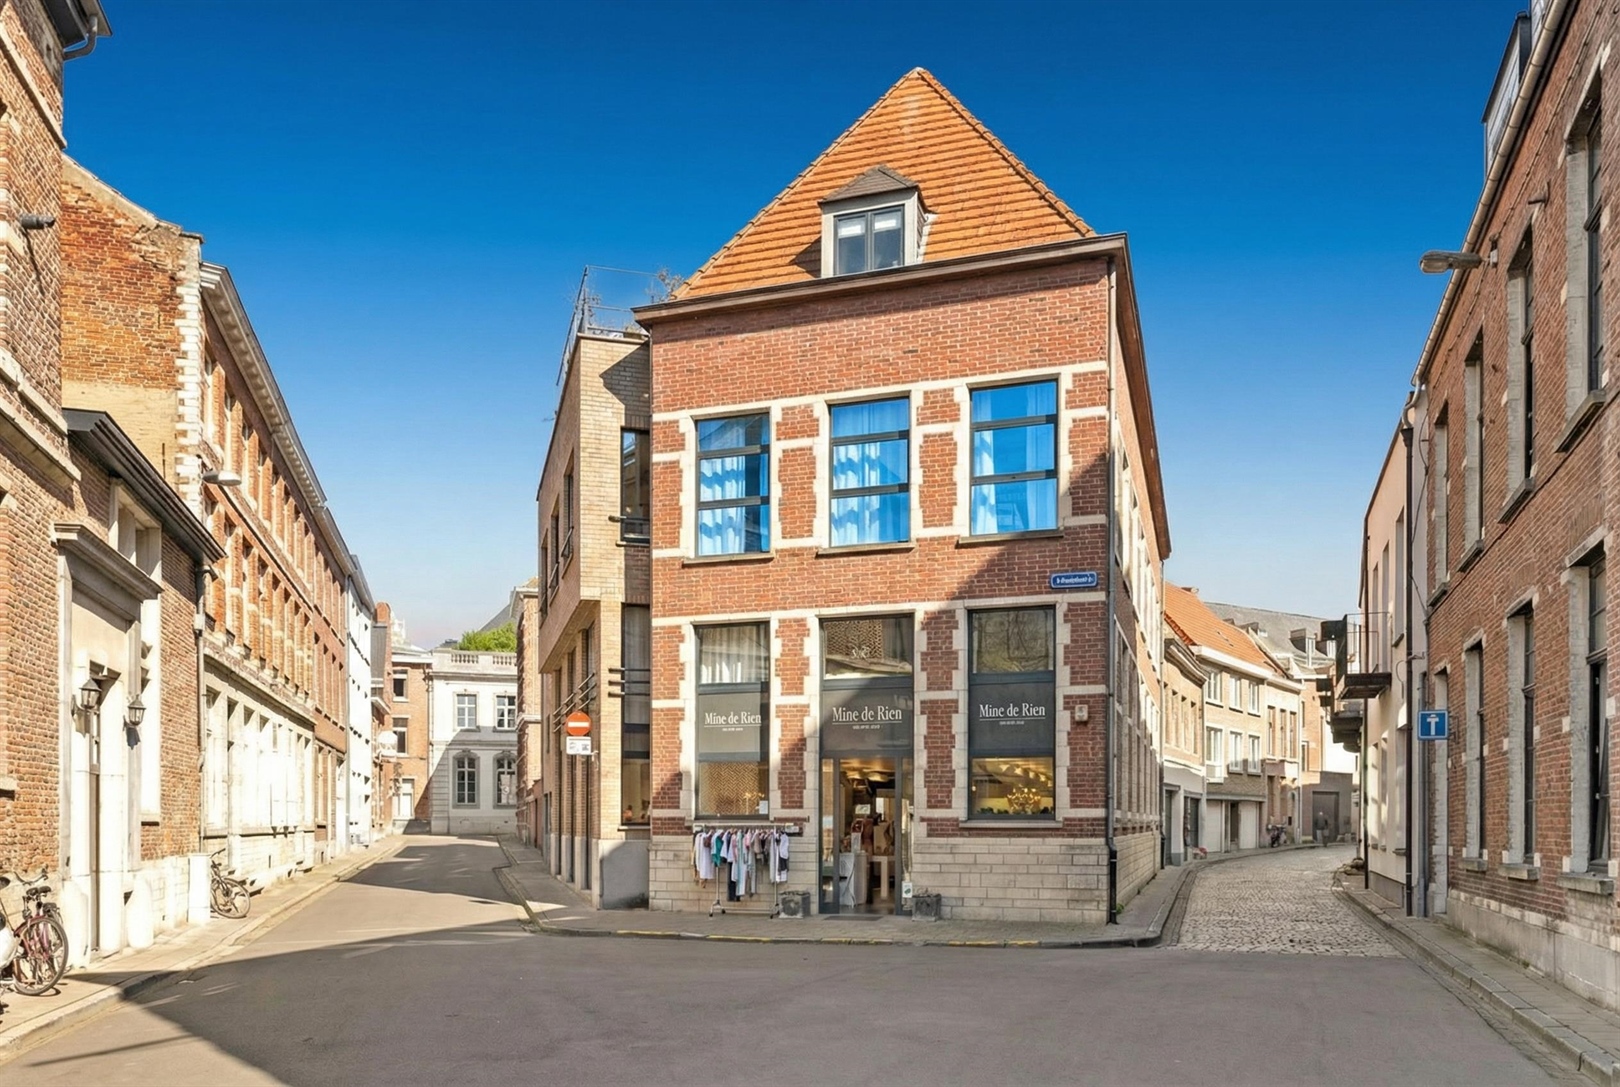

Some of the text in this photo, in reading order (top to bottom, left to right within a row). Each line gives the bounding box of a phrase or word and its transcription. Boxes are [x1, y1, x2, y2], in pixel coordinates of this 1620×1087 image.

[704, 711, 762, 725] Mine de Rien
[832, 705, 902, 722] Mine de Rien
[979, 702, 1046, 718] Mine de Rien
